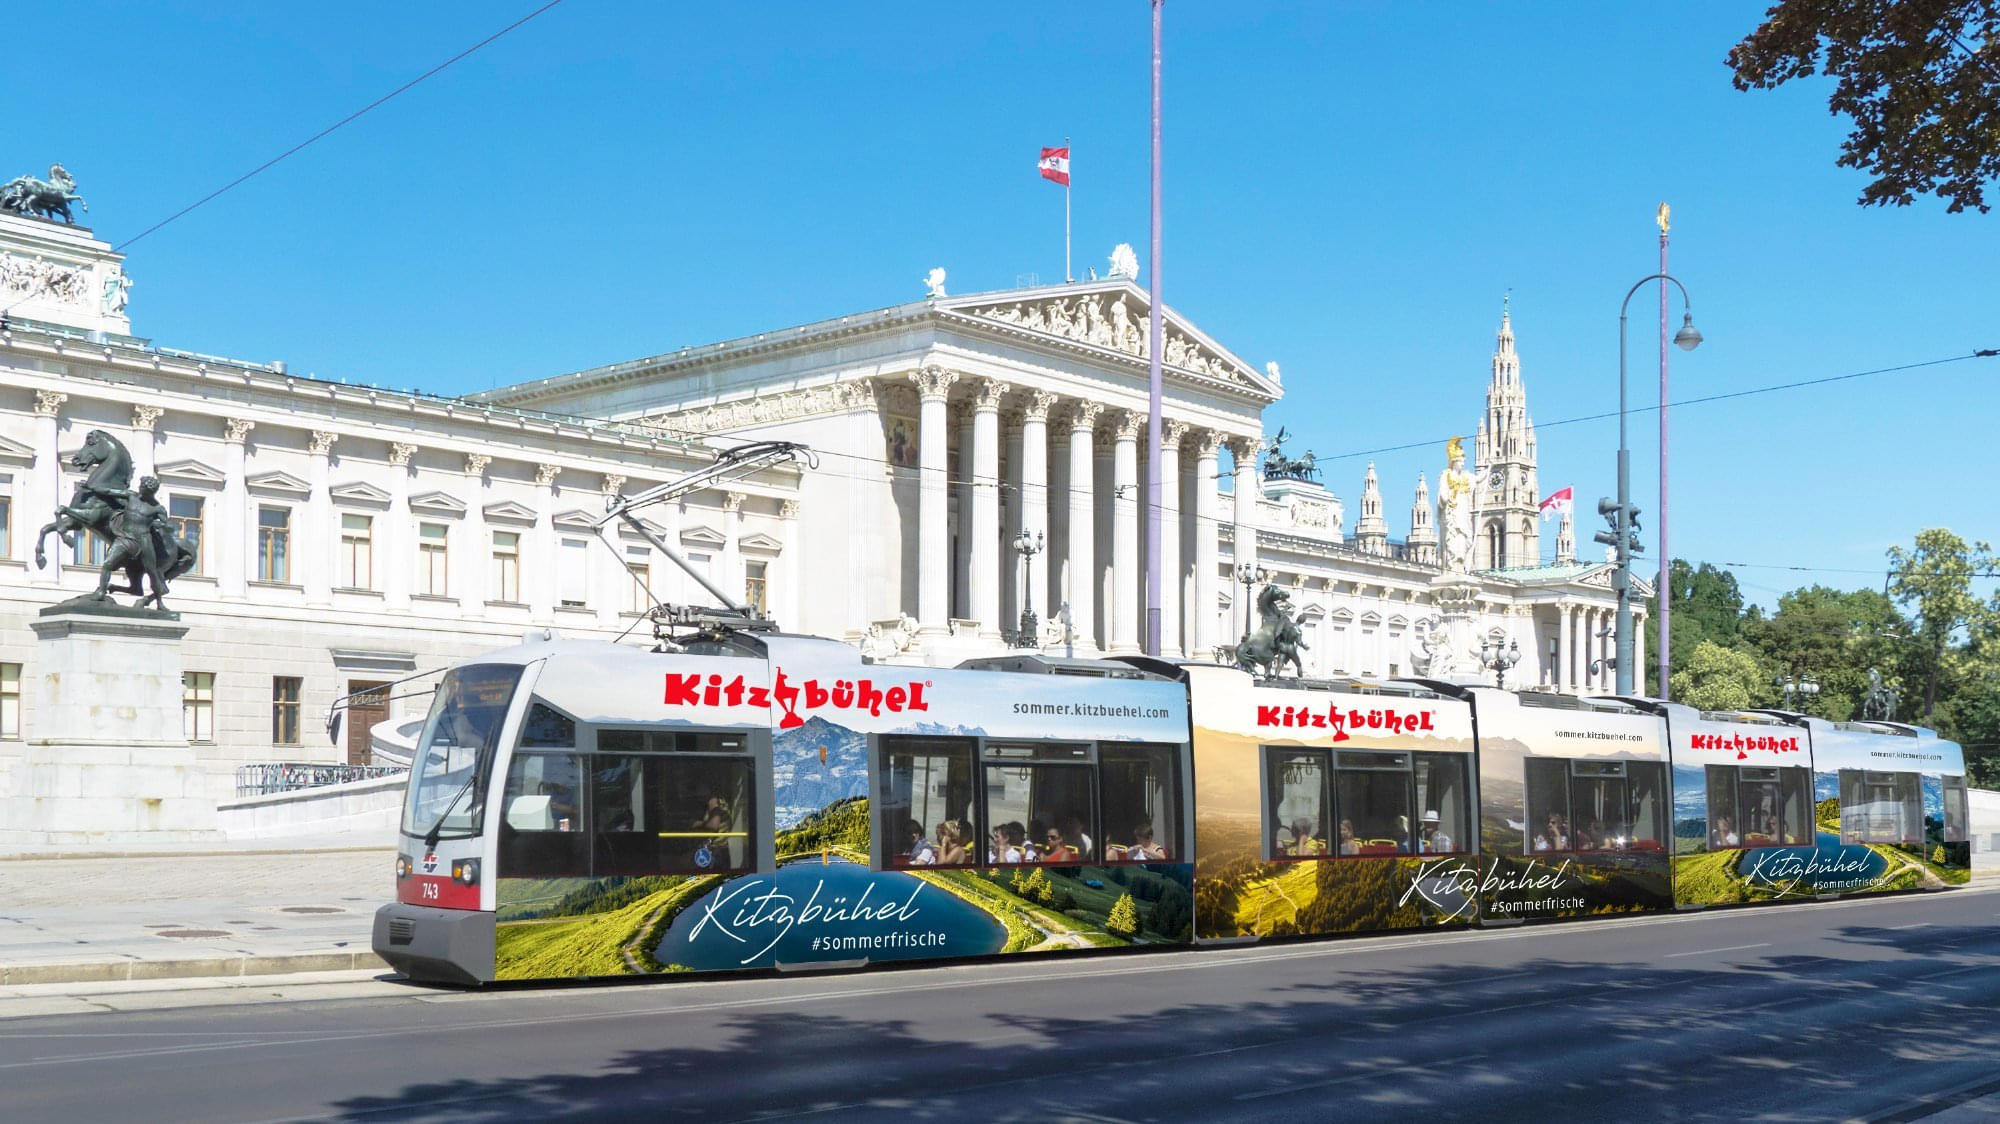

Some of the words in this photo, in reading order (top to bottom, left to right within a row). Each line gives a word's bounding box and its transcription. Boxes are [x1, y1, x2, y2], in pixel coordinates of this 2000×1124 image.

[1013, 702, 1170, 719] sommer.kitzbuehel.com
[1554, 730, 1643, 742] sommer.kitzbuehel.com
[1745, 847, 1873, 899] Kitzbühel
[423, 883, 439, 899] 743
[1399, 857, 1571, 925] Kitzbühel
[1490, 897, 1585, 913] #Sommerfrische
[688, 879, 927, 964] Kitzbühel
[811, 931, 946, 951] #Sommerfrische
